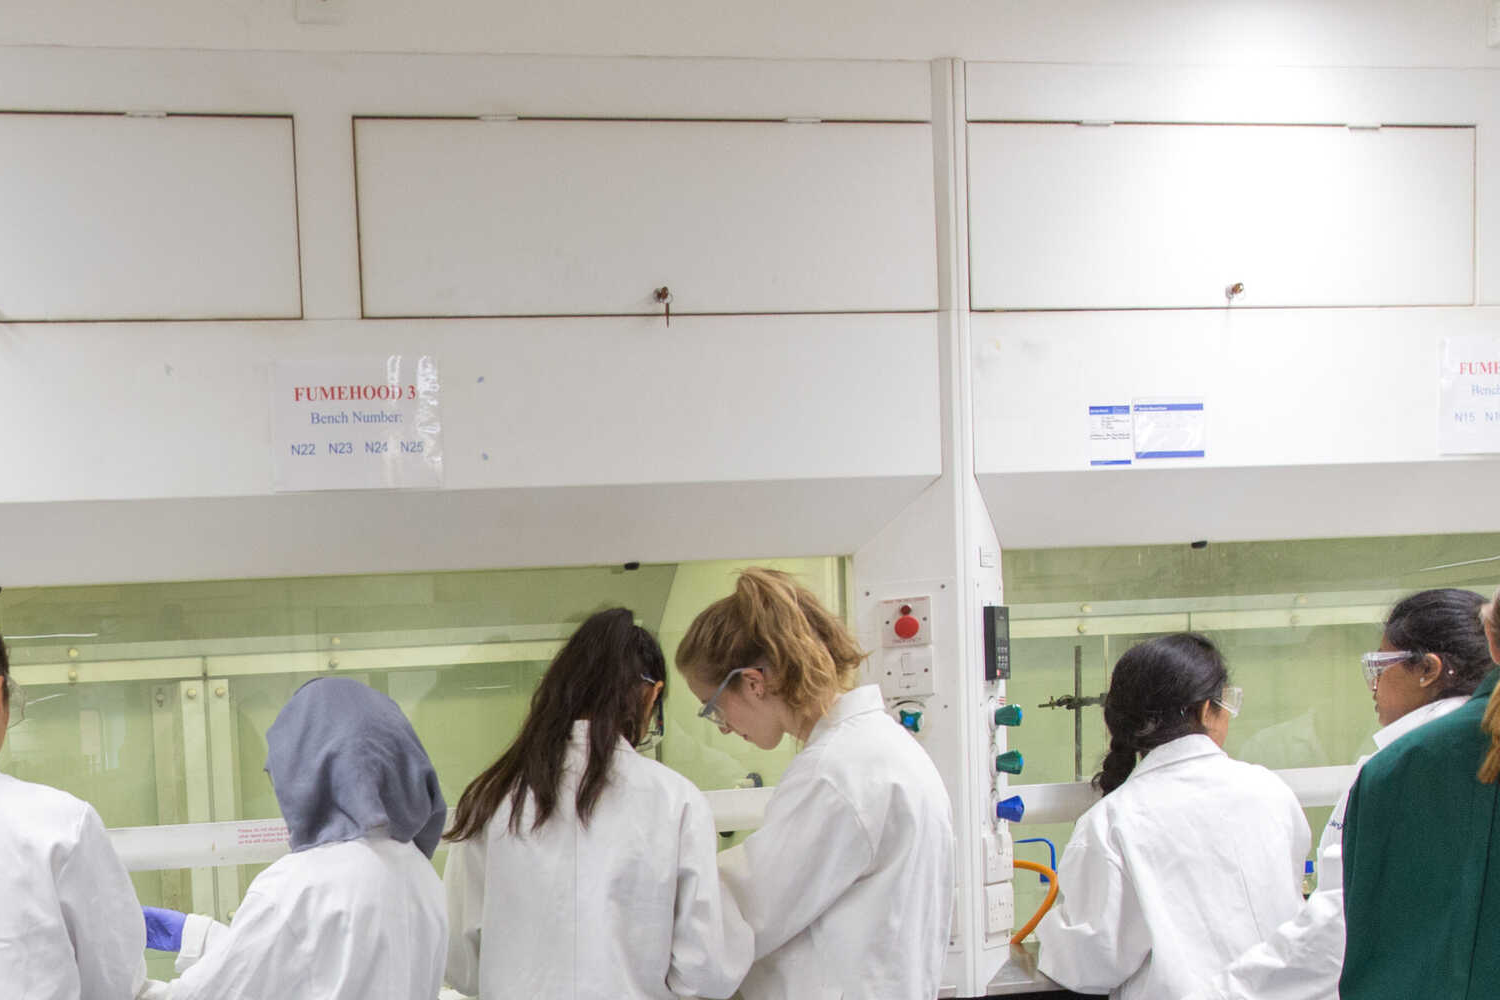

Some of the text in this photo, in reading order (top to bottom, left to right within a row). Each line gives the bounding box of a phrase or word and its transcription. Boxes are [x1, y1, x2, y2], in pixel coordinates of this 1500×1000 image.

[293, 385, 416, 401] FUMEHOOD 3
[310, 412, 349, 424] Bench
[291, 440, 424, 455] N22 N23 N24 N25
